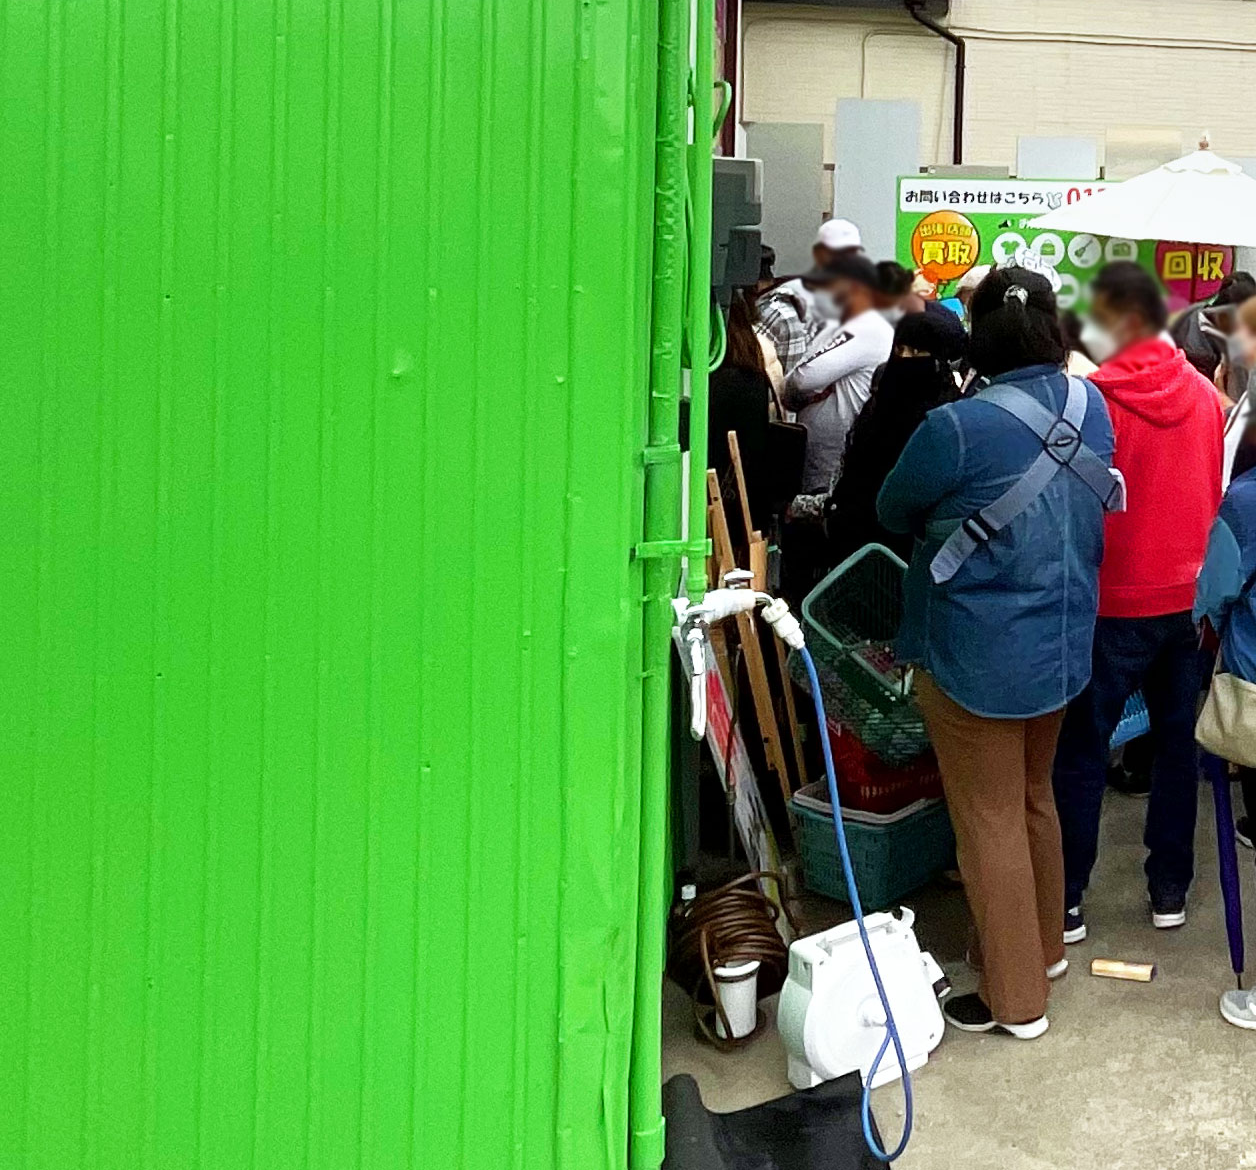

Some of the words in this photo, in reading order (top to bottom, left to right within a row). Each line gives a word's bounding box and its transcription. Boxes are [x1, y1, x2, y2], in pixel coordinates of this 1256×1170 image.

[905, 189, 1044, 205] お問い合わせはこちら
[921, 240, 972, 265] 買取
[1162, 250, 1225, 281] 回収
